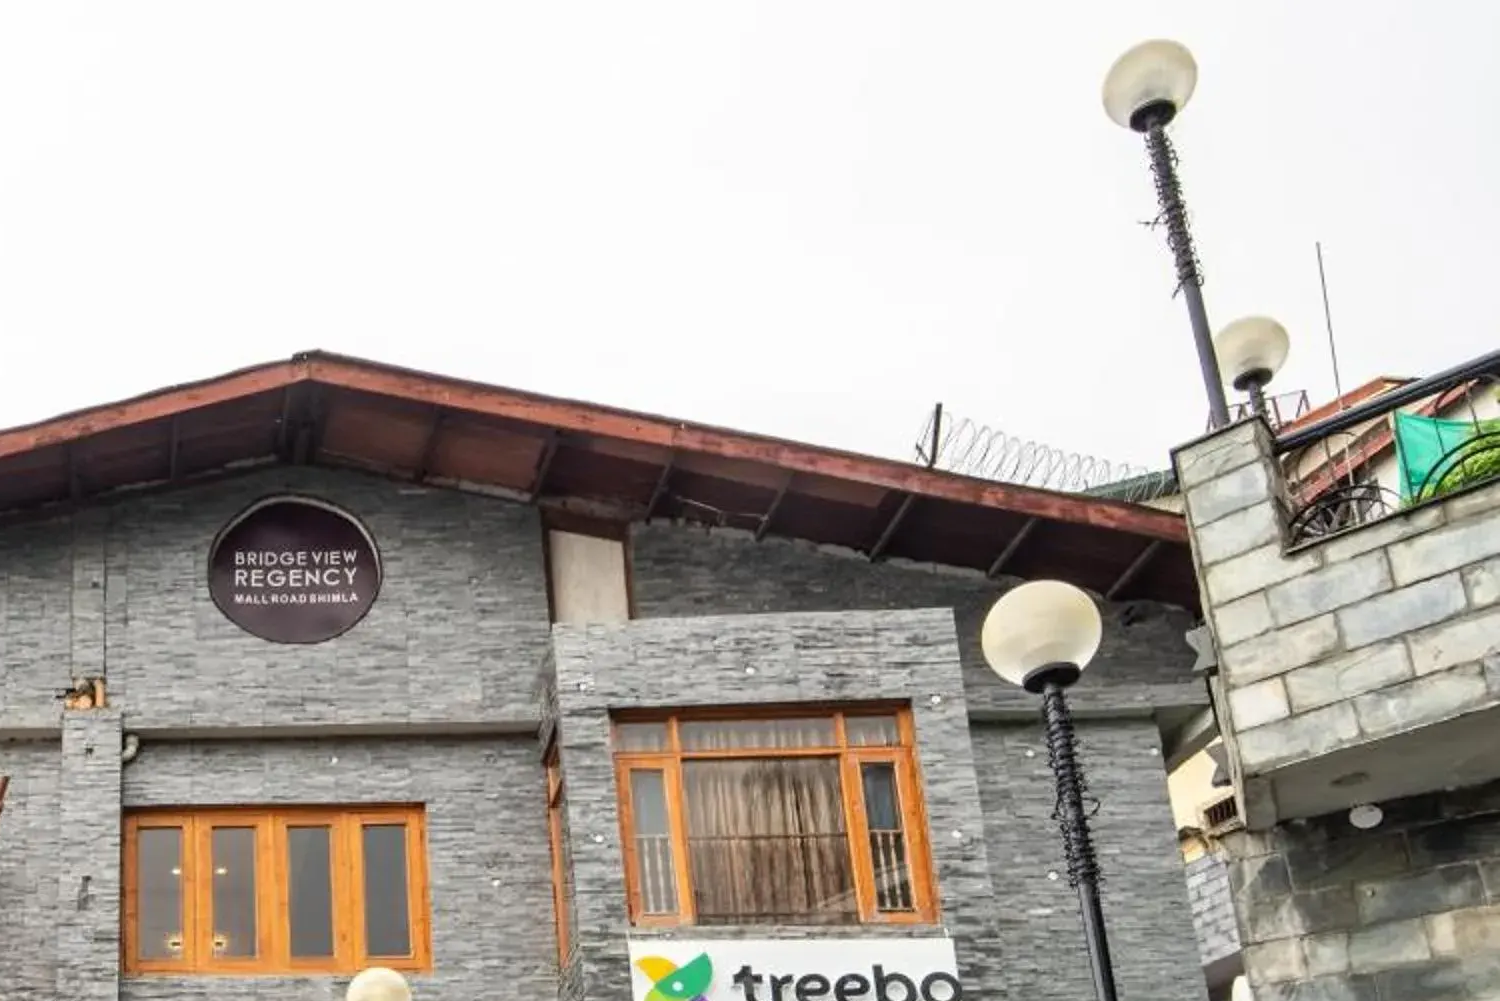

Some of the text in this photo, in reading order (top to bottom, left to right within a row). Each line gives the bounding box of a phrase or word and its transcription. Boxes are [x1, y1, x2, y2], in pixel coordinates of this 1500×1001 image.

[235, 551, 357, 566] BRIDGE VIEW
[235, 568, 357, 588] REGENCY
[235, 592, 358, 605] MALL ROAD SHIMLA
